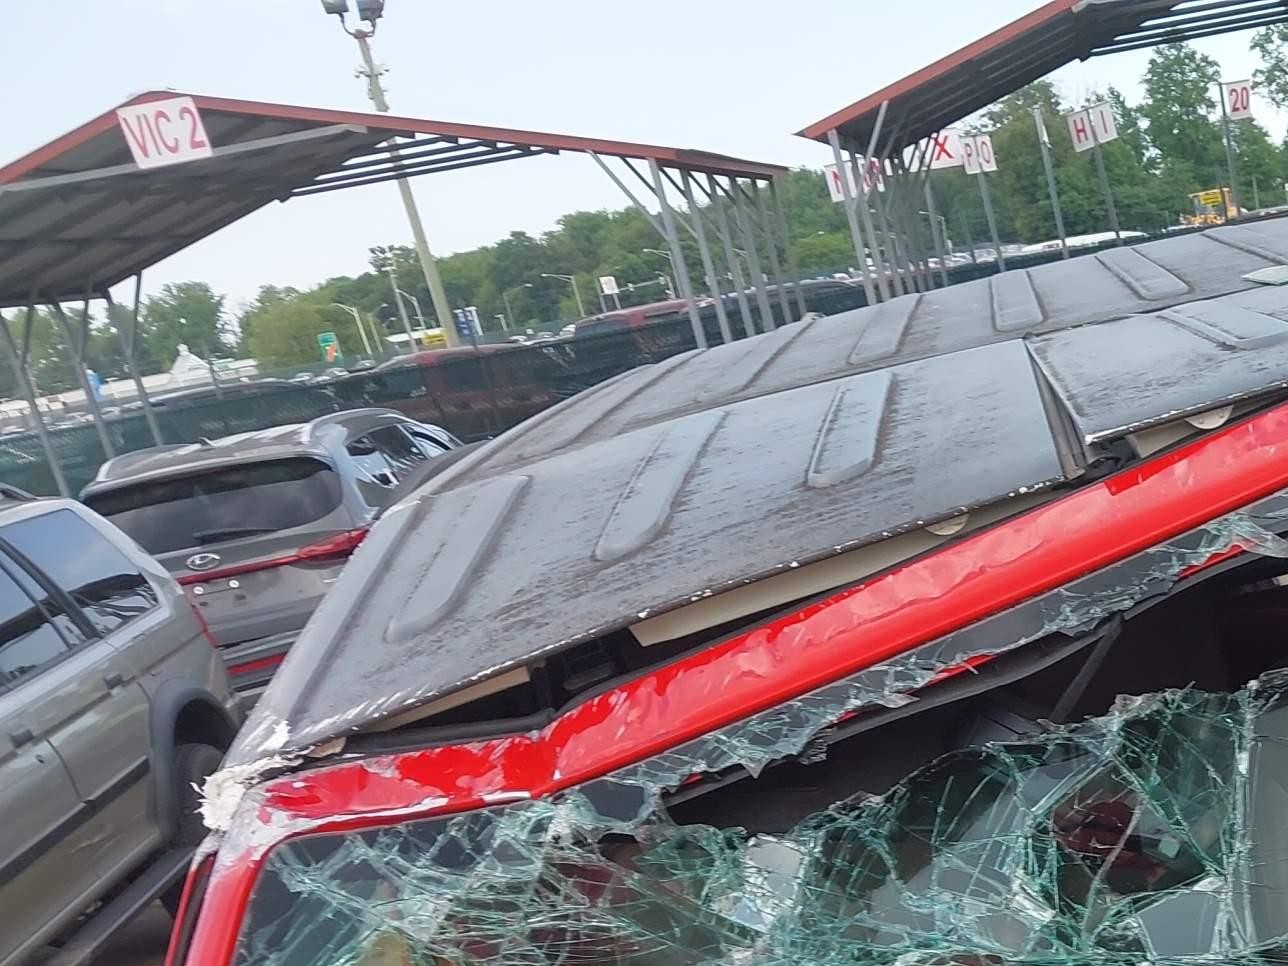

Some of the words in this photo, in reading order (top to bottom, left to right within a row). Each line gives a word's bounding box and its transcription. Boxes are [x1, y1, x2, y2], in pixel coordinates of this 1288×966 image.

[1229, 86, 1250, 113] 20
[122, 109, 179, 159] VIC
[179, 106, 206, 150] 2
[1073, 116, 1088, 144] H
[934, 135, 955, 161] X
[964, 142, 974, 166] P
